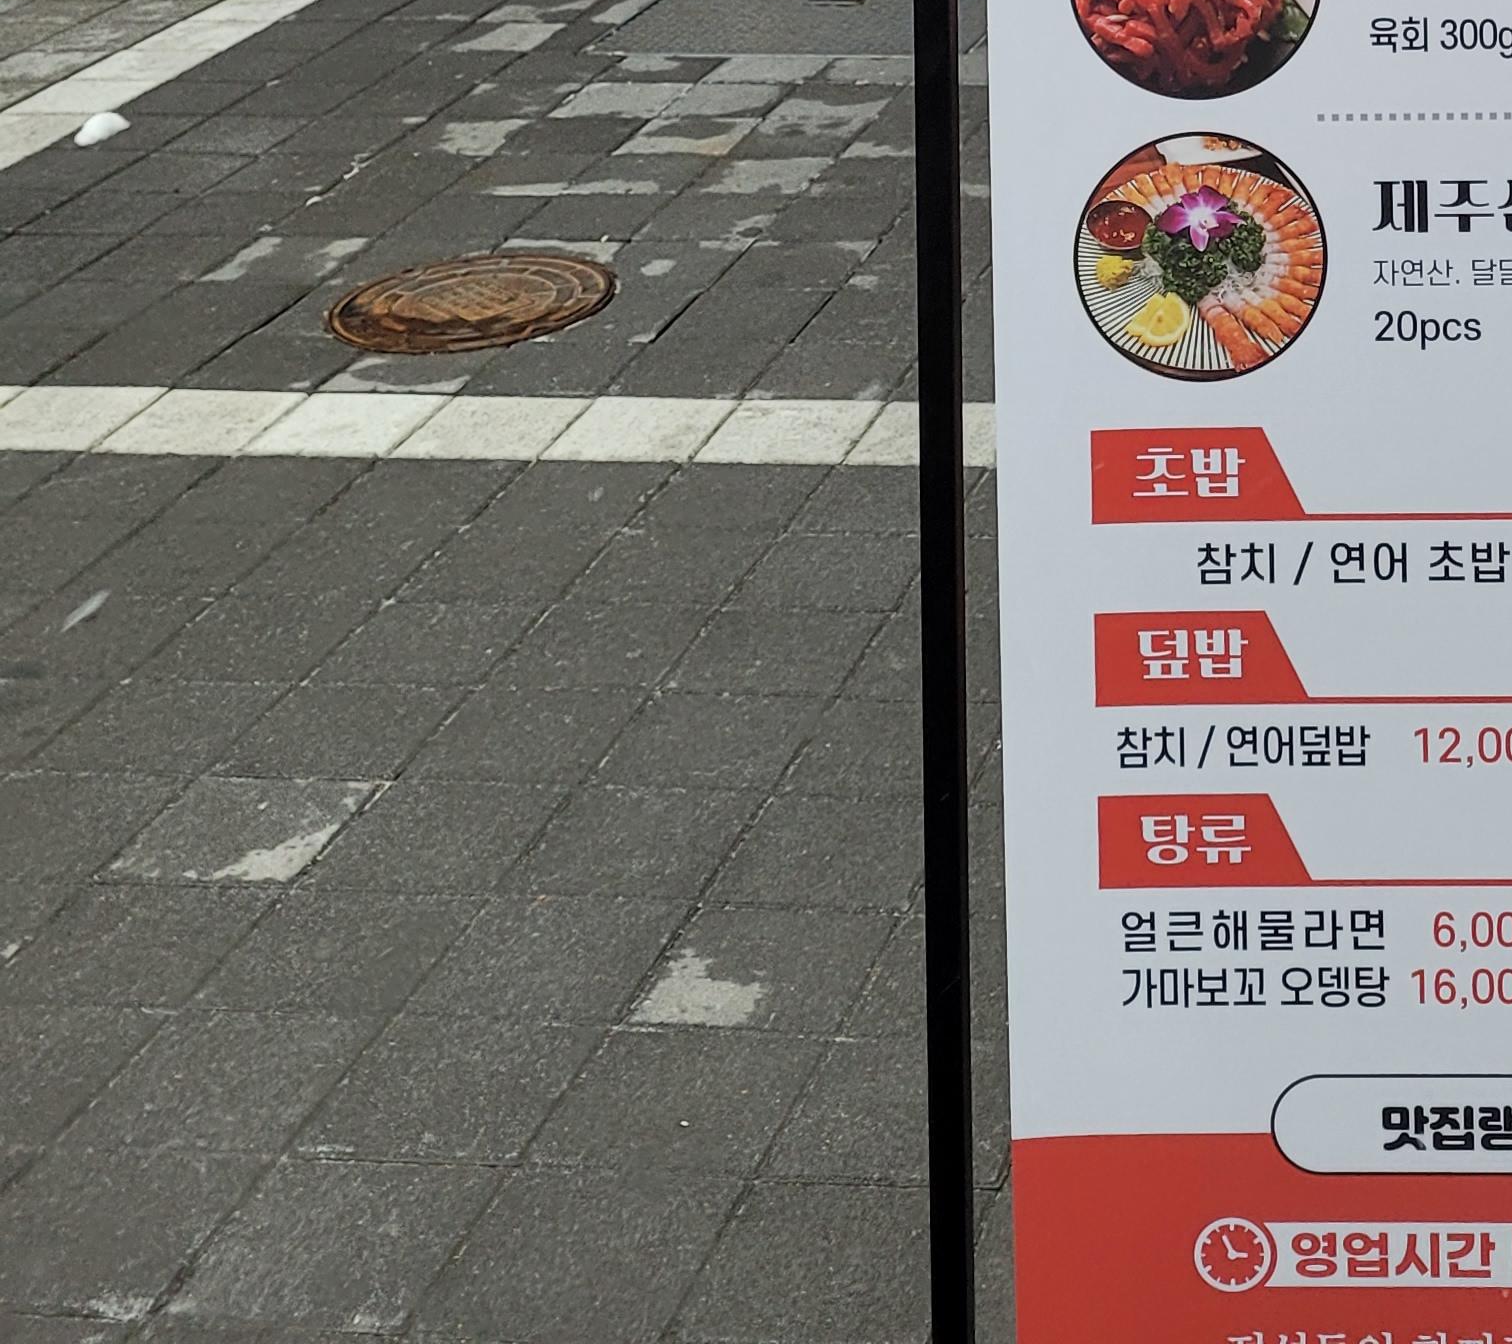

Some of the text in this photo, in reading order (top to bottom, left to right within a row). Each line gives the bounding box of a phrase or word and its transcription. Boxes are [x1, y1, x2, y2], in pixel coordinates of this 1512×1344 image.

[1370, 17, 1428, 53] 육회
[1375, 311, 1481, 350] 20pcs
[1132, 447, 1245, 498] 초밥
[1198, 543, 1274, 584] 참치
[1331, 543, 1407, 583] 연어
[1429, 541, 1510, 583] 초밥
[1138, 628, 1248, 680] 덮밥
[1117, 726, 1184, 768] 참치
[1227, 726, 1370, 766] 연어덮밥
[1141, 815, 1251, 865] 탕류
[1122, 910, 1384, 952] 얼큰해물라면
[1123, 968, 1266, 1008] 가마보꼬
[1292, 1232, 1495, 1278] 영업시간
